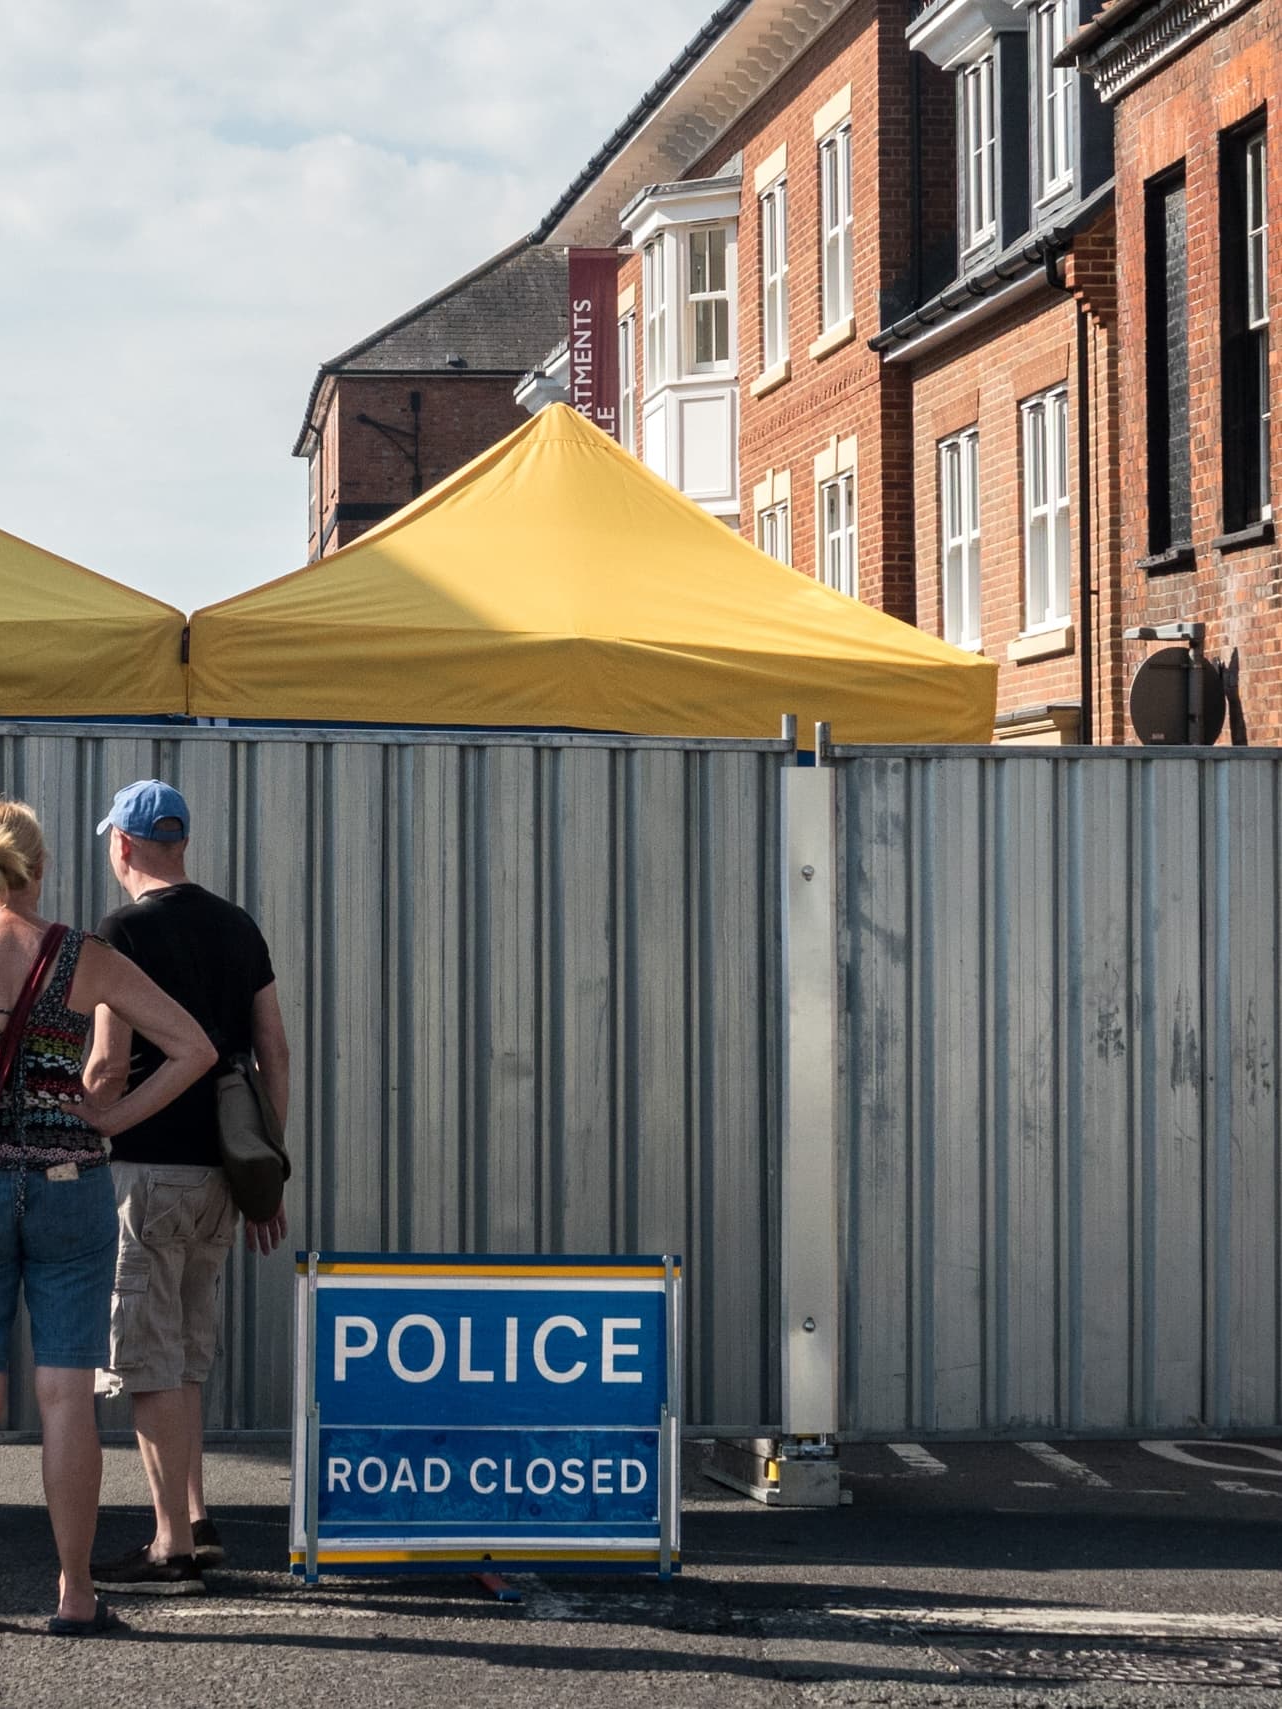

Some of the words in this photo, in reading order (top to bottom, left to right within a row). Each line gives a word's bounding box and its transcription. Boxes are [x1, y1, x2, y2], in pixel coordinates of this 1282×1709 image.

[574, 299, 592, 422] RTMENTS
[596, 406, 615, 440] LE
[334, 1313, 643, 1384] POLICE
[327, 1456, 451, 1494] ROAD
[469, 1457, 648, 1495] CLOSED
